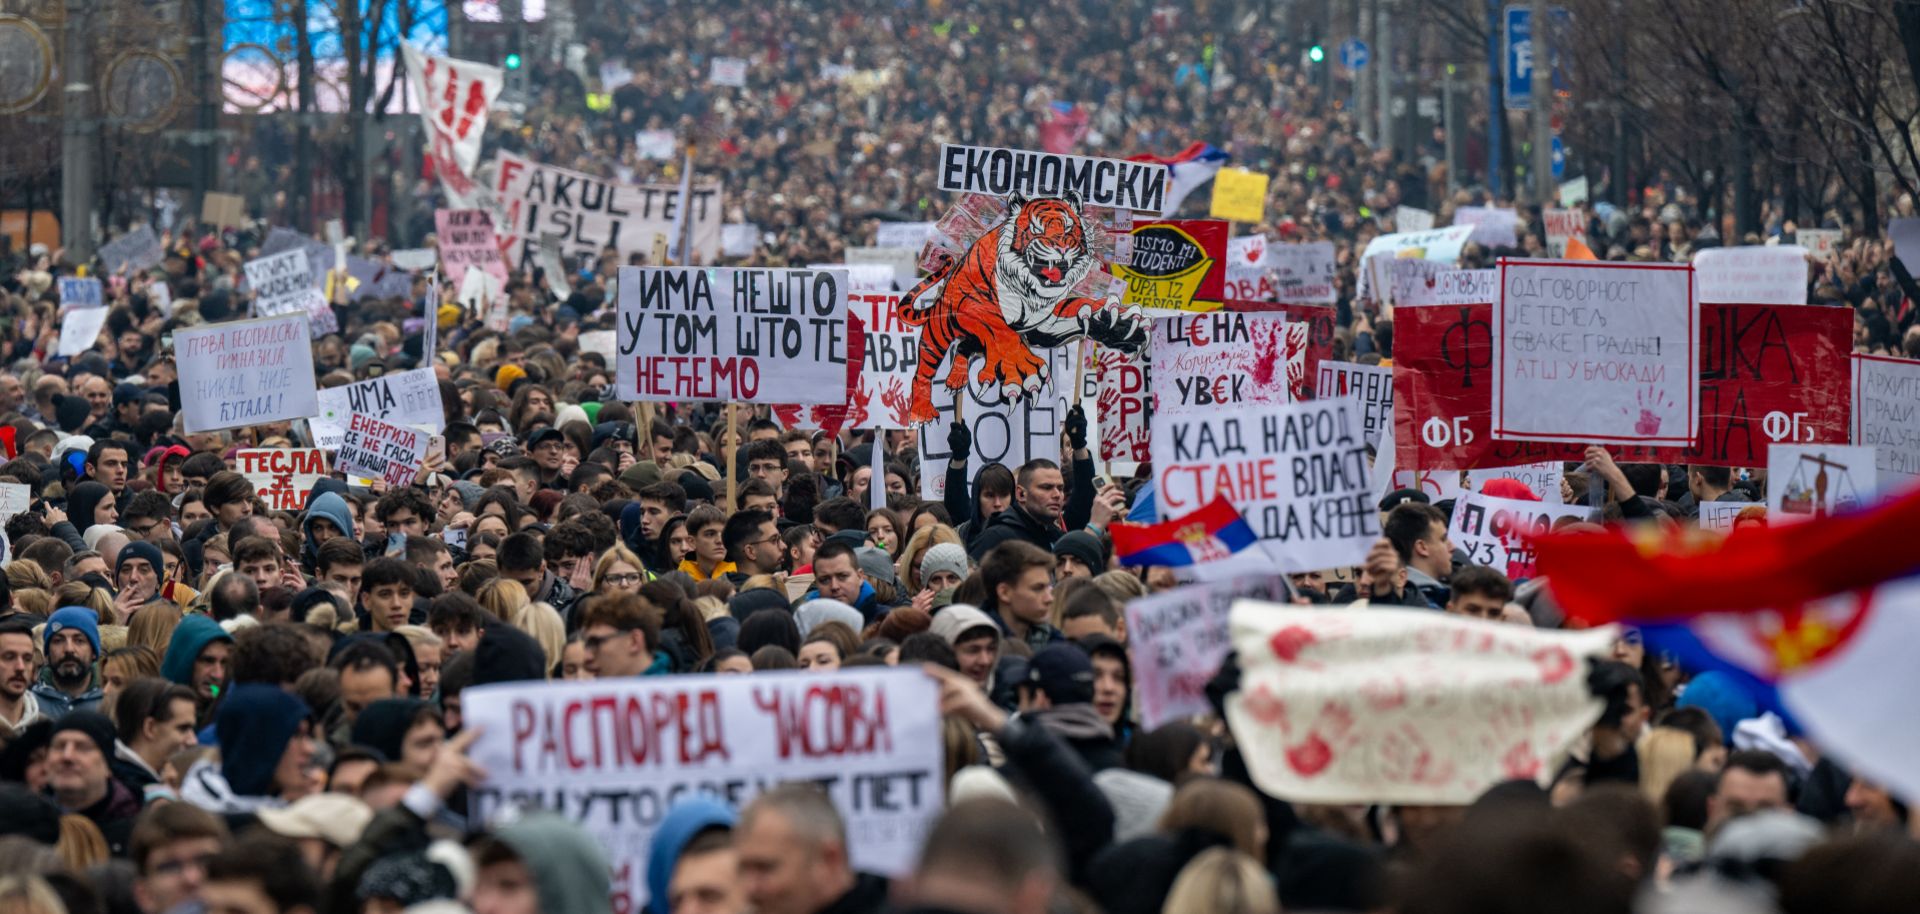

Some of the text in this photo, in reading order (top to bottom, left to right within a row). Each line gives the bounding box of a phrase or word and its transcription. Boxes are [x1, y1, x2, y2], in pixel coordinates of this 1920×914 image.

[943, 146, 1165, 211] ЕКОНОМСКИ
[1132, 250, 1187, 271] TUDENTI
[639, 269, 837, 316] ИМА НЕШТО
[1167, 281, 1184, 298] IZ
[1510, 276, 1640, 301] ОДГОВОРНОСТ
[1508, 304, 1608, 328] ЈЕ ТЕМЕЉ
[186, 321, 301, 357] ПРВА БЕОГРАДСКА
[620, 312, 847, 364] У ТОМ ШТО ТЕ
[1512, 331, 1573, 353] СВАКЕ
[216, 346, 285, 370] ГИМНАЗИЈА
[1514, 359, 1666, 383] АТШ У БЛОКАДИ
[196, 367, 293, 401] НИКАД НИЈЕ
[636, 356, 760, 399] НЕЋЕМО
[1319, 367, 1393, 404] ПРАВД
[347, 378, 397, 413] ИМА
[1865, 397, 1915, 423] ГРАДИ
[344, 431, 359, 445] СЕ
[362, 437, 381, 452] НЕ
[350, 413, 416, 449] ЕНЕРГИЈА
[1172, 418, 1247, 461] КАД
[1262, 407, 1354, 453] НАРОД
[238, 450, 325, 474] ТЕСЛА
[340, 446, 357, 462] НИ
[358, 452, 388, 475] НАША
[271, 474, 293, 489] ЈЕ
[1161, 459, 1277, 508] СТАНЕ
[1292, 449, 1369, 497] ВЛАСТ
[1538, 472, 1556, 489] НЕ
[1260, 504, 1304, 541] ДА
[1463, 539, 1495, 565] УЗ
[511, 683, 893, 772] РАСПОРЕД ЧАСОВА
[851, 769, 929, 812] ПЕТ
